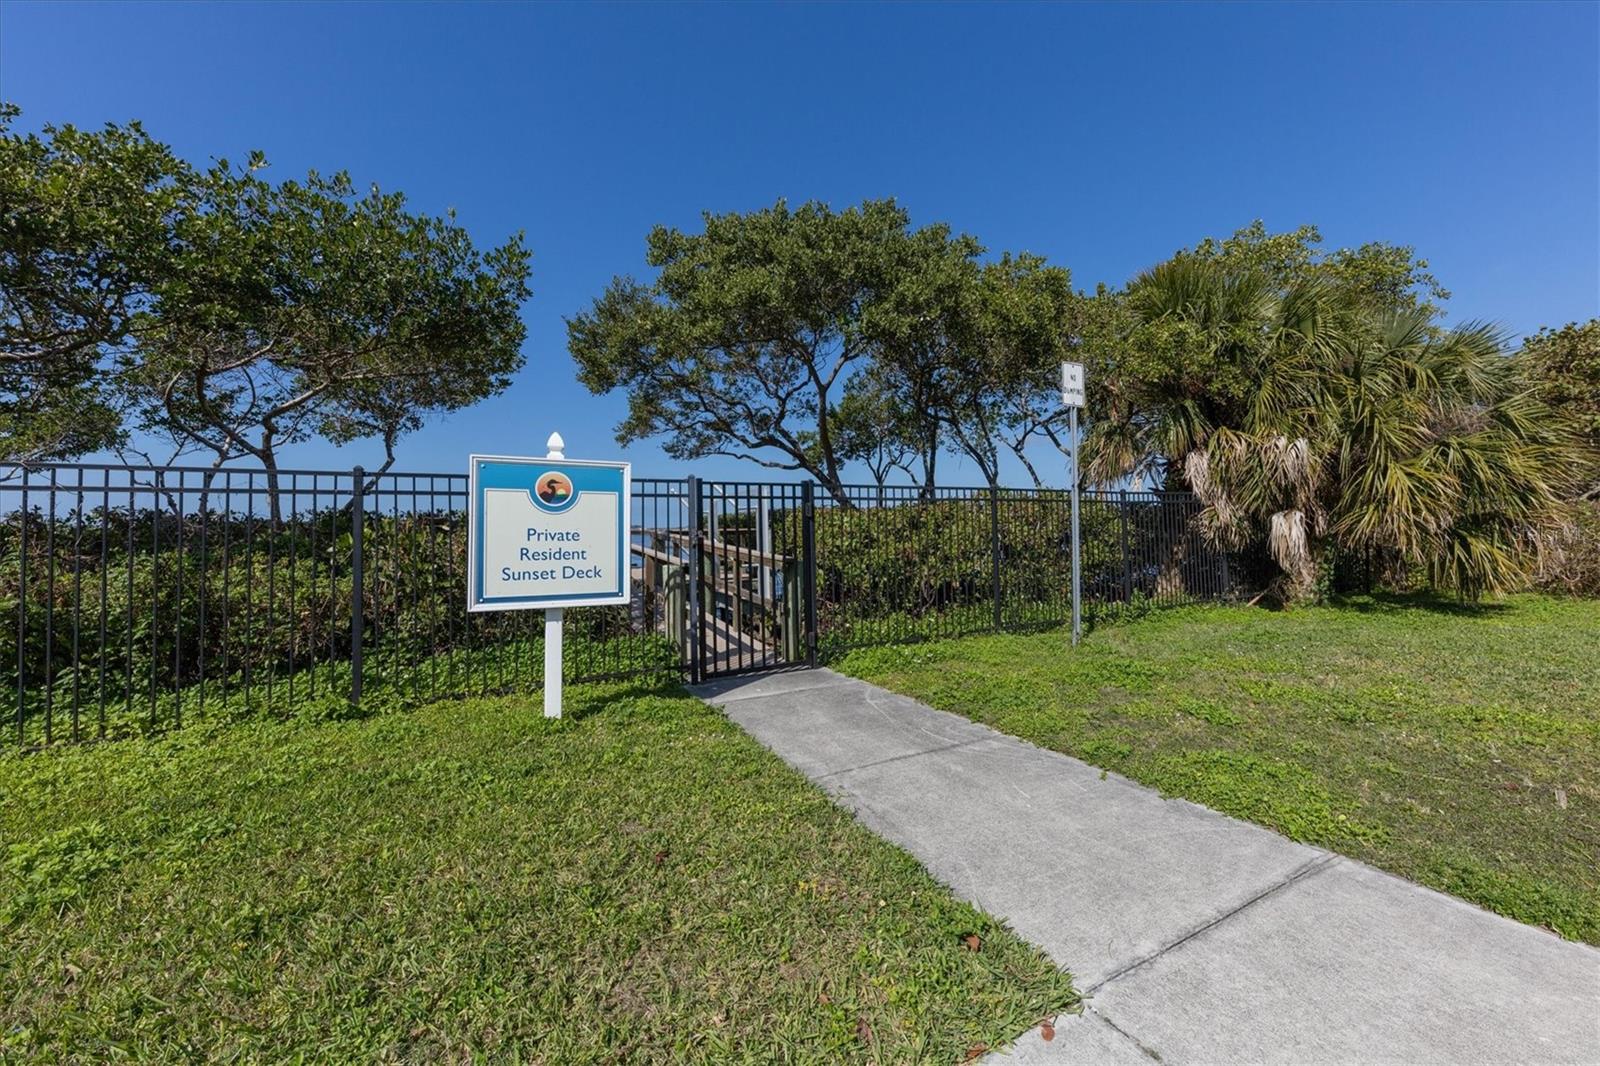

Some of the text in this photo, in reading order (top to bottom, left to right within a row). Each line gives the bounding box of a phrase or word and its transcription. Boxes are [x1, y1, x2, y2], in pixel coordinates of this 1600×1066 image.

[527, 528, 581, 542] Private
[520, 547, 587, 562] Resident
[502, 565, 602, 581] Sunset Deck
